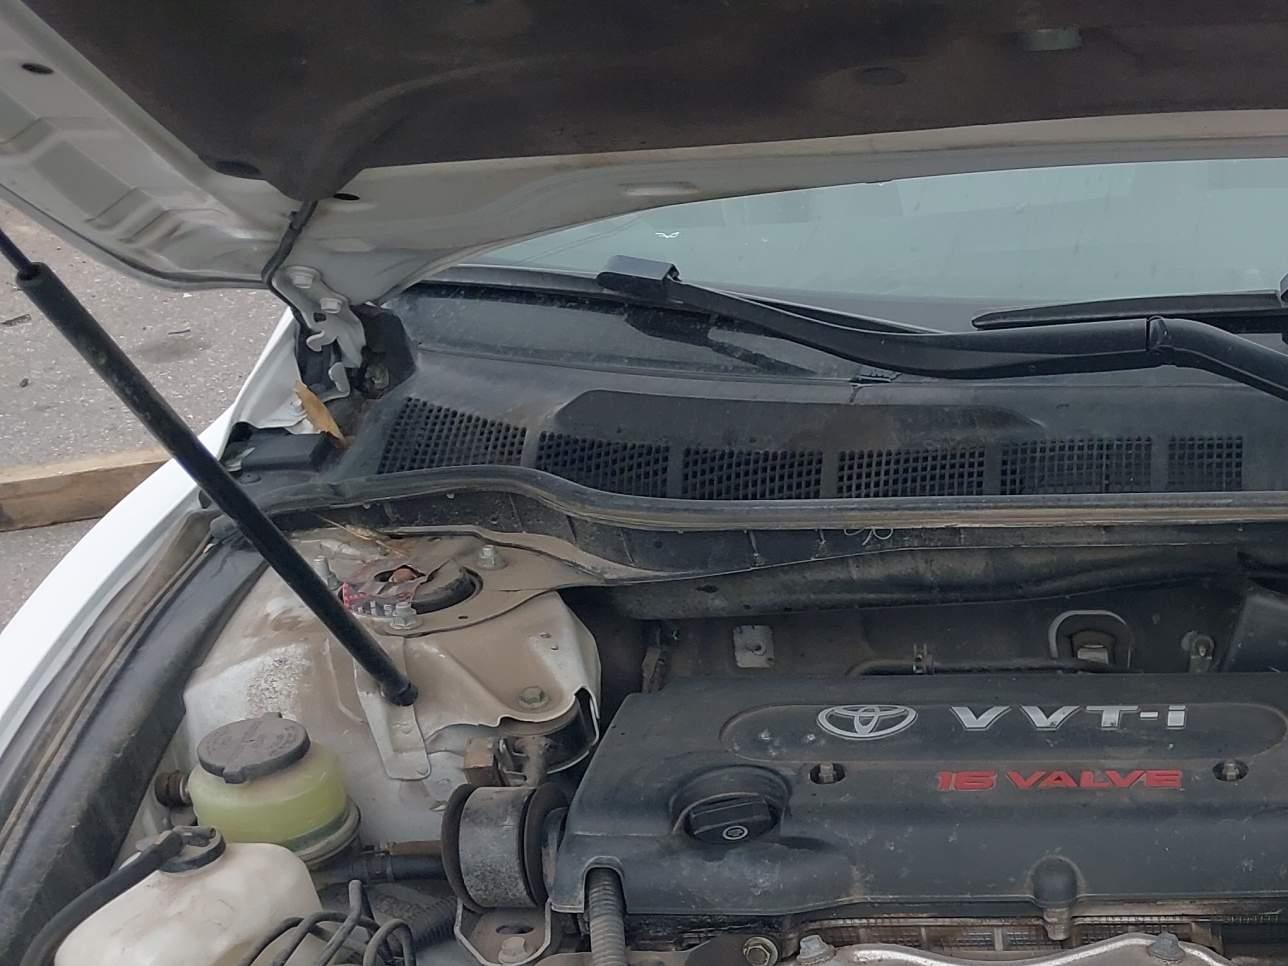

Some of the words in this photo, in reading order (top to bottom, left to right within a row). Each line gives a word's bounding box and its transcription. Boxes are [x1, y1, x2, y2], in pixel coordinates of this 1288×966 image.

[950, 704, 1187, 731] VVT-i
[937, 770, 997, 791] 16
[1006, 769, 1184, 791] VALVE
